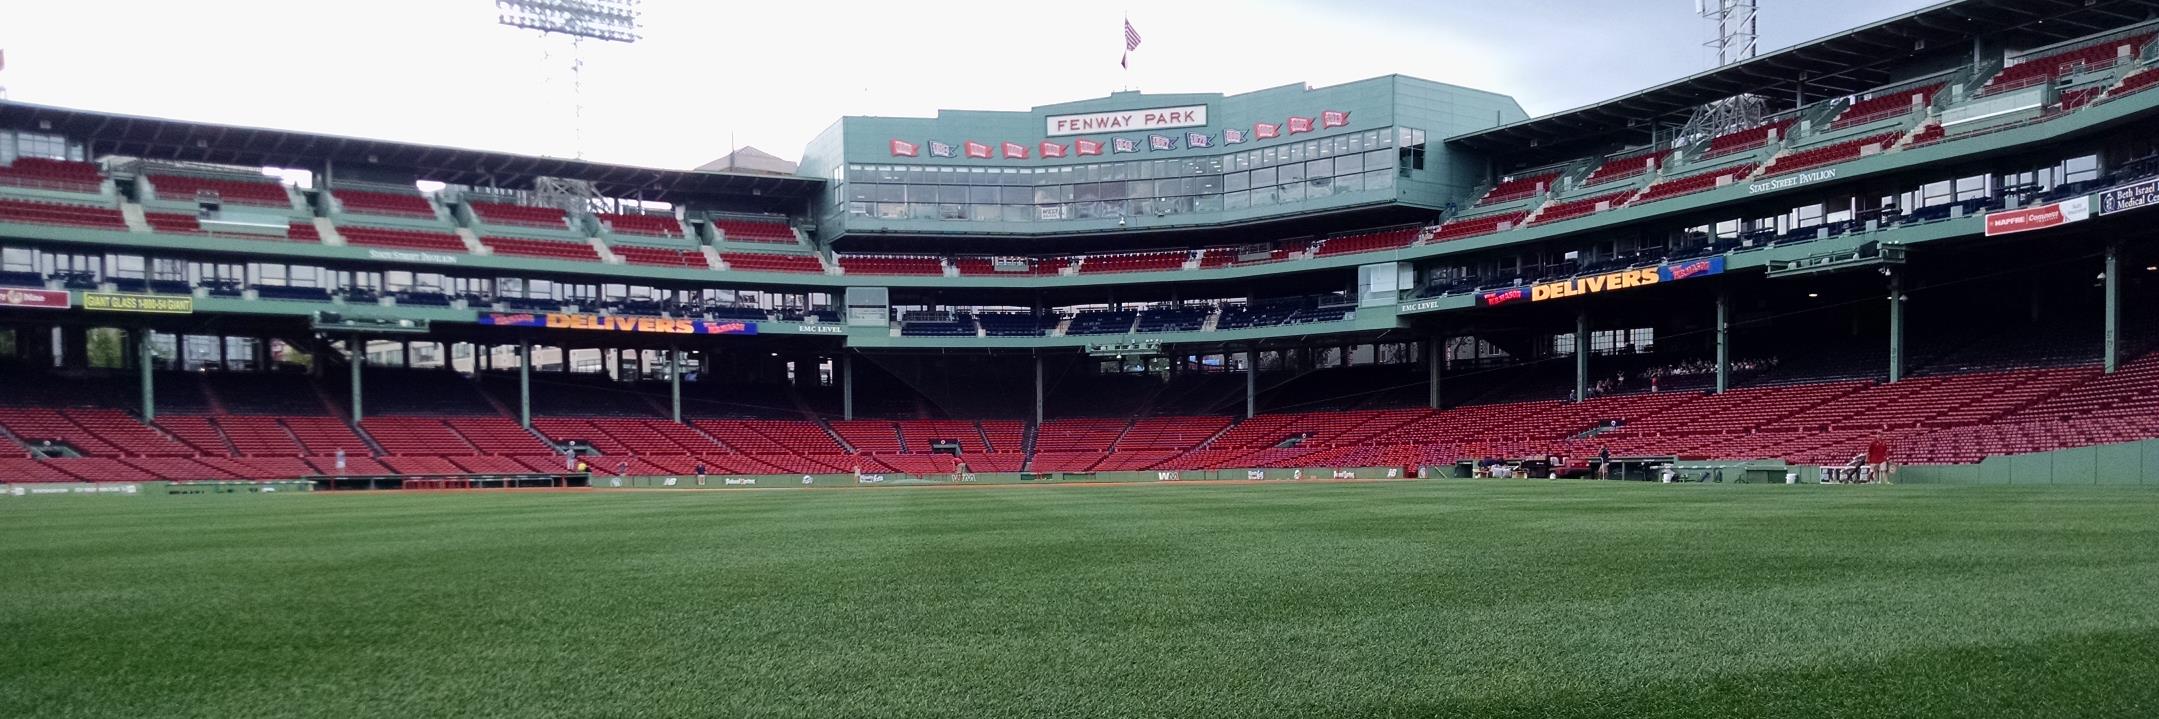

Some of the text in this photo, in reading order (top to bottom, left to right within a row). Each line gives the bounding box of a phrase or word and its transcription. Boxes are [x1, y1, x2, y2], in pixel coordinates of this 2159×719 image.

[1057, 110, 1195, 131] FENWAY PARK
[1749, 169, 1836, 194] STATE STREET PAVILION
[2117, 182, 2155, 200] Beth Israel
[2117, 195, 2145, 210] Medical
[1994, 216, 2025, 226] MAPFRE
[1532, 267, 1660, 301] DELIVERS
[1402, 301, 1440, 312] EMC LEVEL
[545, 312, 695, 334] DELIVERS
